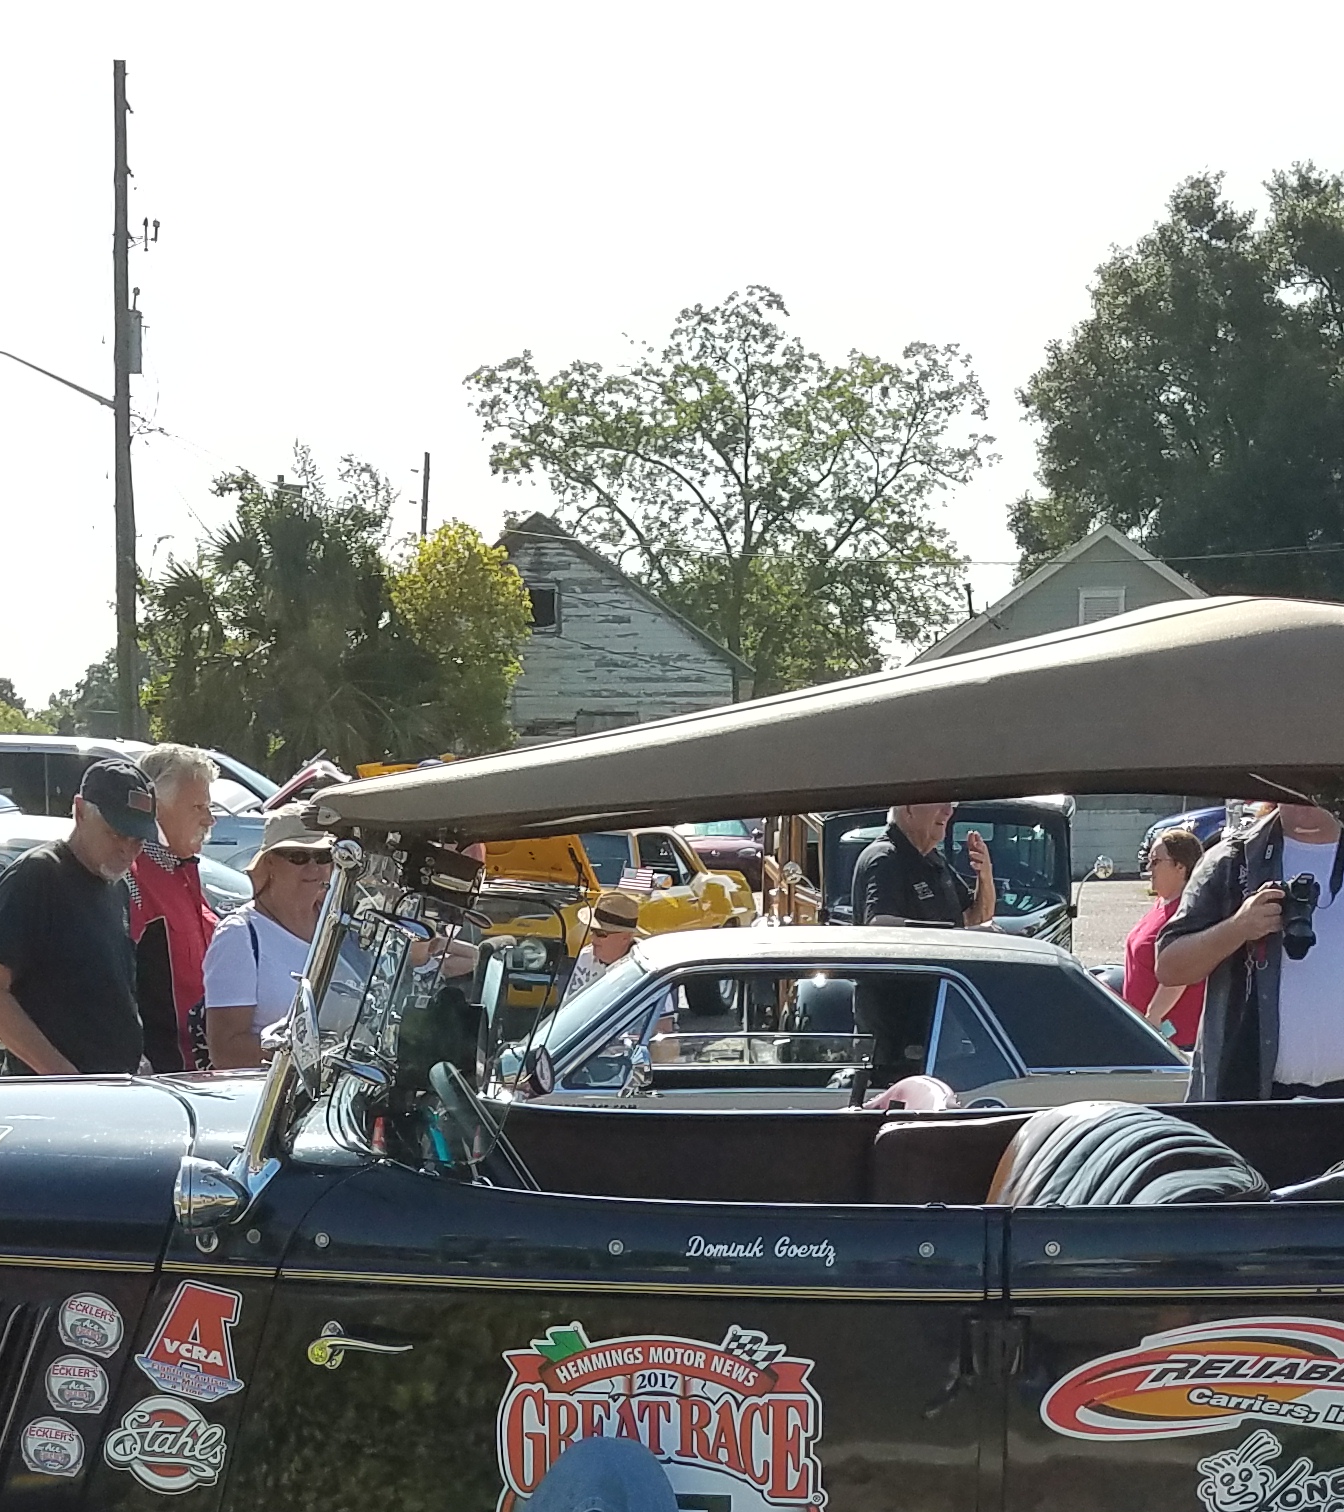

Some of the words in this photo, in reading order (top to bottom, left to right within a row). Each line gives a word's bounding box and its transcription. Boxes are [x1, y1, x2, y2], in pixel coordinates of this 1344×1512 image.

[686, 1235, 764, 1258] Dominik
[774, 1236, 837, 1267] Goertz
[163, 1337, 224, 1367] VCRA
[555, 1346, 644, 1385] HEMMINGS
[648, 1346, 706, 1370] MOTOR
[710, 1354, 760, 1389] NEWS
[636, 1371, 680, 1391] 2017
[1186, 1386, 1320, 1423] Carriers,
[674, 1397, 809, 1499] RACE
